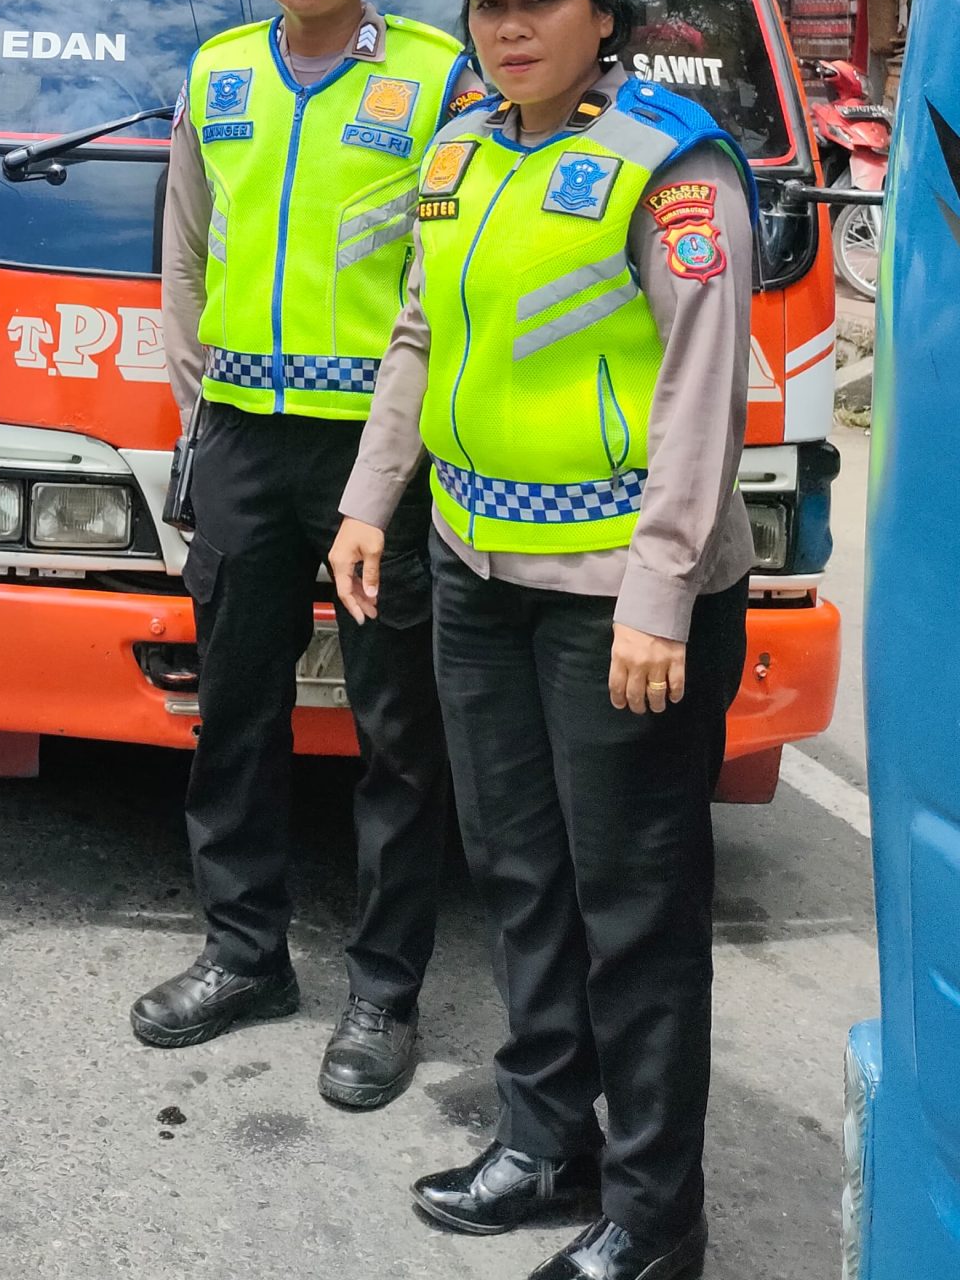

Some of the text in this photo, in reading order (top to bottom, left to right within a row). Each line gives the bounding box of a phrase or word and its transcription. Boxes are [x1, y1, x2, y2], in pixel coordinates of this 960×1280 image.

[632, 53, 722, 86] SAWIT
[345, 127, 411, 155] POLRI
[649, 184, 709, 206] POLRES
[654, 191, 709, 210] LANGKAT
[419, 201, 456, 218] ESTER
